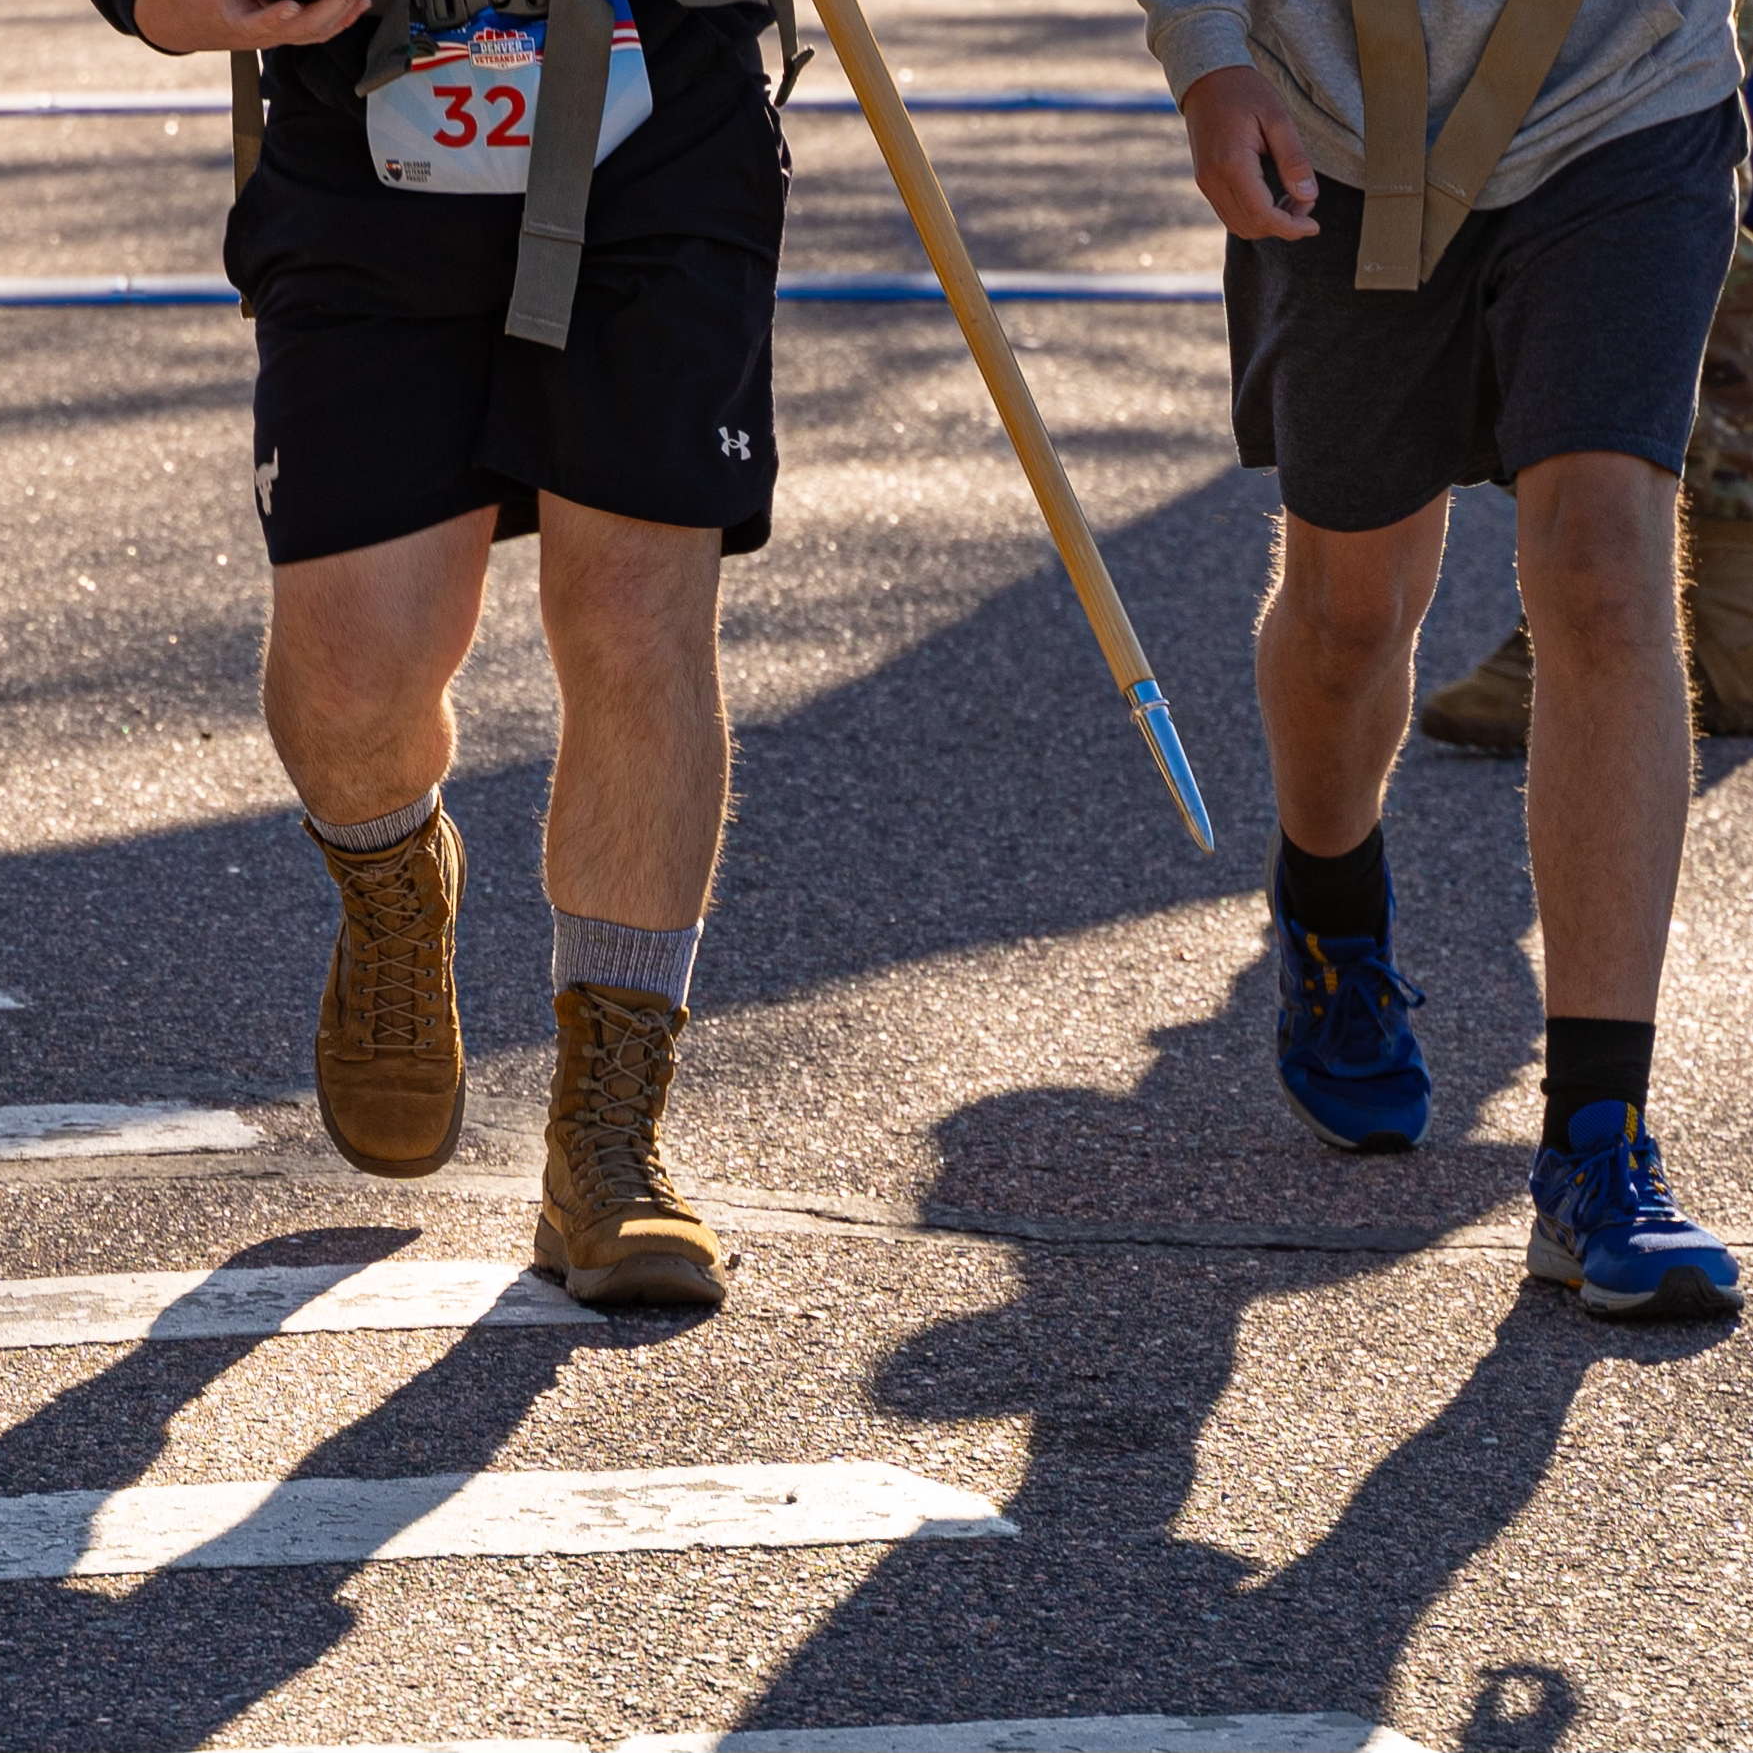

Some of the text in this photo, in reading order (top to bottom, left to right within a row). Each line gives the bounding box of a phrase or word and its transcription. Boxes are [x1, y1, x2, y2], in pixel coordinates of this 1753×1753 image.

[480, 41, 522, 54] DENVER
[474, 52, 531, 64] VETERANS DAY
[432, 85, 531, 148] 32
